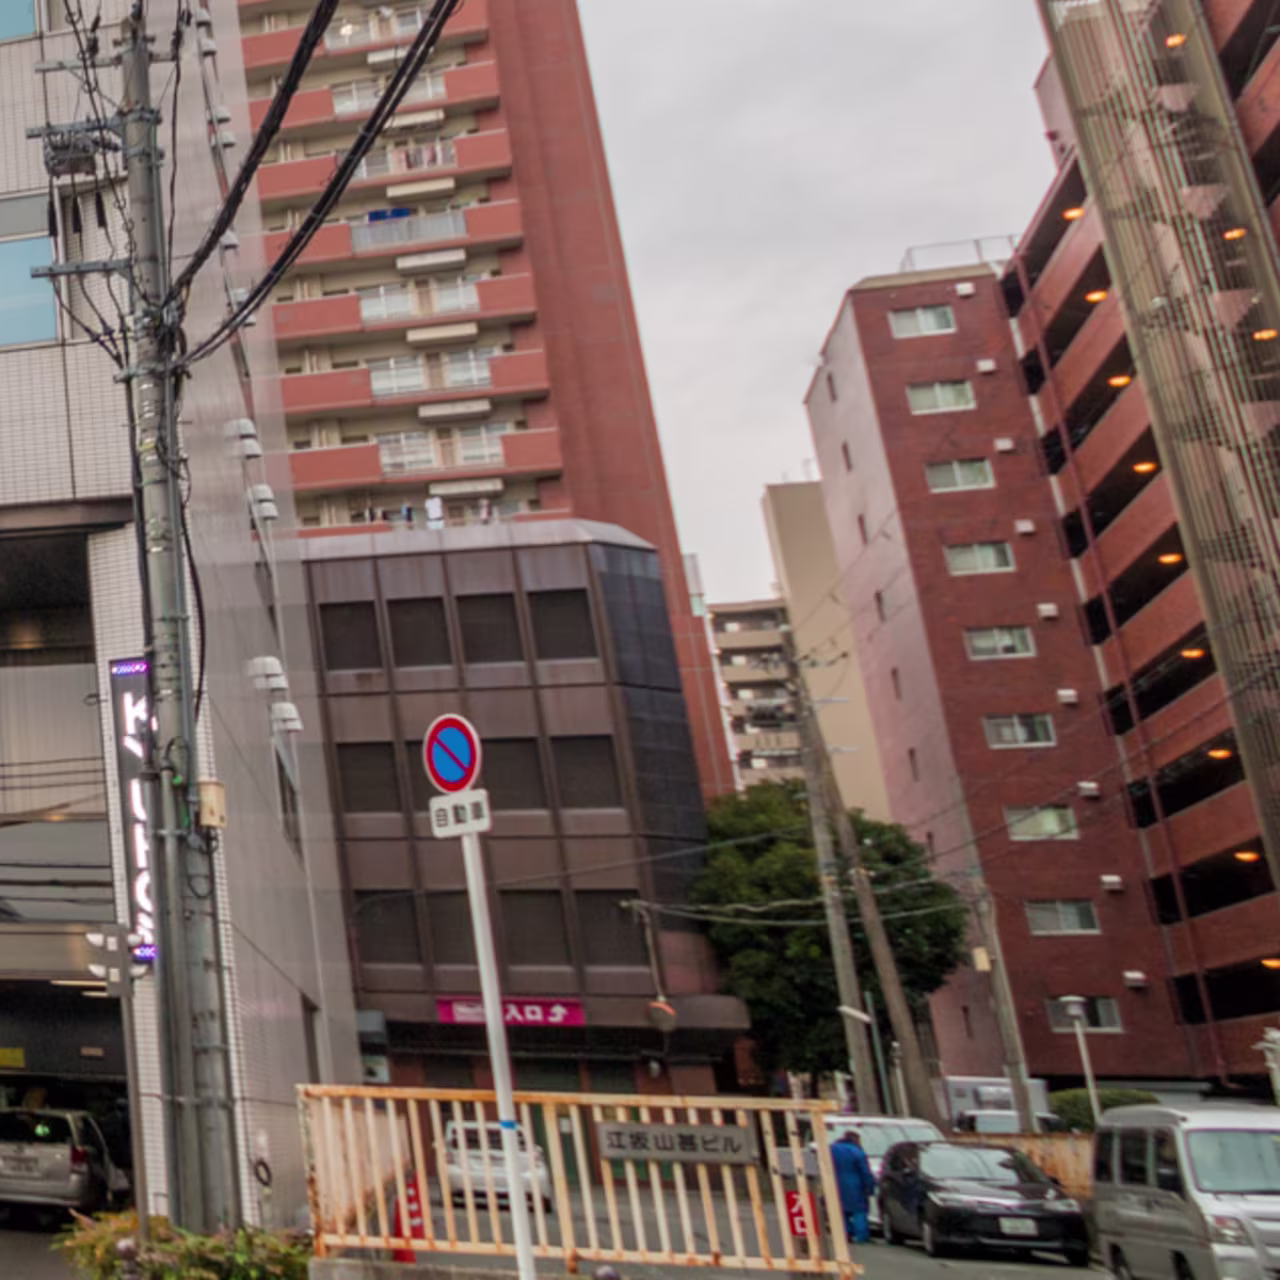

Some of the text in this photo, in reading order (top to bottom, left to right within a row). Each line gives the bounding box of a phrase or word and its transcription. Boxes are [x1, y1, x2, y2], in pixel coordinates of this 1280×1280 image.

[435, 802, 484, 827] 自動車
[505, 1004, 544, 1021] 入口
